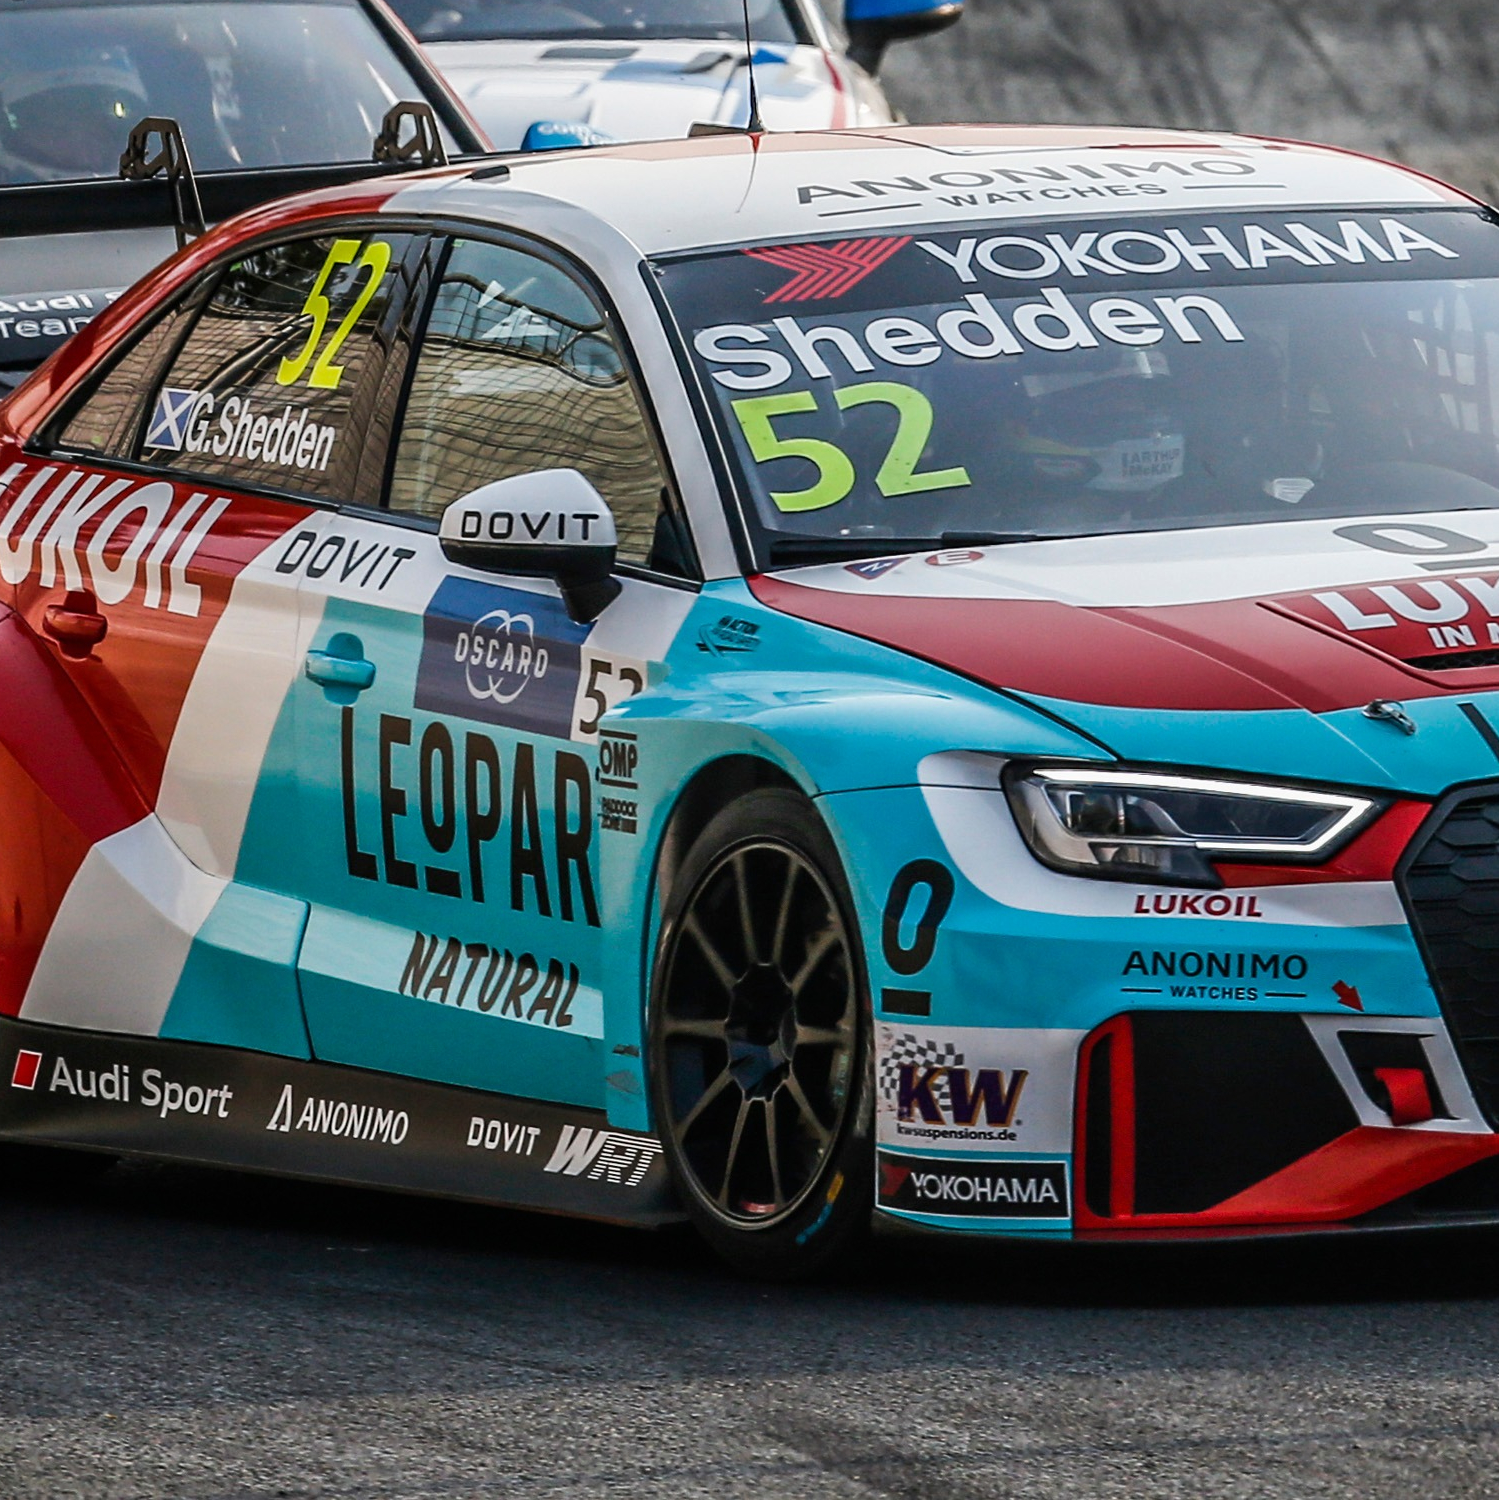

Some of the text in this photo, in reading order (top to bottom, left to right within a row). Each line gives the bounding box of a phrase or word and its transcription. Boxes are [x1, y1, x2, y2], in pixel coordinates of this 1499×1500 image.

[797, 159, 1256, 205] ANONIMO
[936, 182, 1167, 209] WATCHES
[915, 218, 1459, 284] YOKOHAMA
[276, 239, 391, 390] 52
[692, 287, 1245, 392] Shedden
[185, 392, 336, 472] G.Shedden
[731, 381, 972, 514] 52
[461, 512, 600, 541] DOVIT
[276, 530, 416, 592] DOVIT
[455, 630, 550, 680] OSCARO
[1427, 624, 1476, 649] IN
[600, 740, 638, 779] OMP
[341, 705, 601, 929] LEOPAR
[1134, 894, 1263, 918] LUKOIL
[399, 929, 579, 1028] NATURAL
[1122, 950, 1309, 980] ANONIMO
[1169, 985, 1258, 1001] WATCHES
[49, 1056, 233, 1118] Audi Sport
[896, 1062, 1030, 1128] KW
[296, 1095, 410, 1146] ANONIMO
[466, 1116, 542, 1157] DOVIT
[896, 1123, 1018, 1141] kwsuspensions.de
[543, 1123, 665, 1187] WRT
[910, 1171, 1060, 1204] YOKOHAMA
